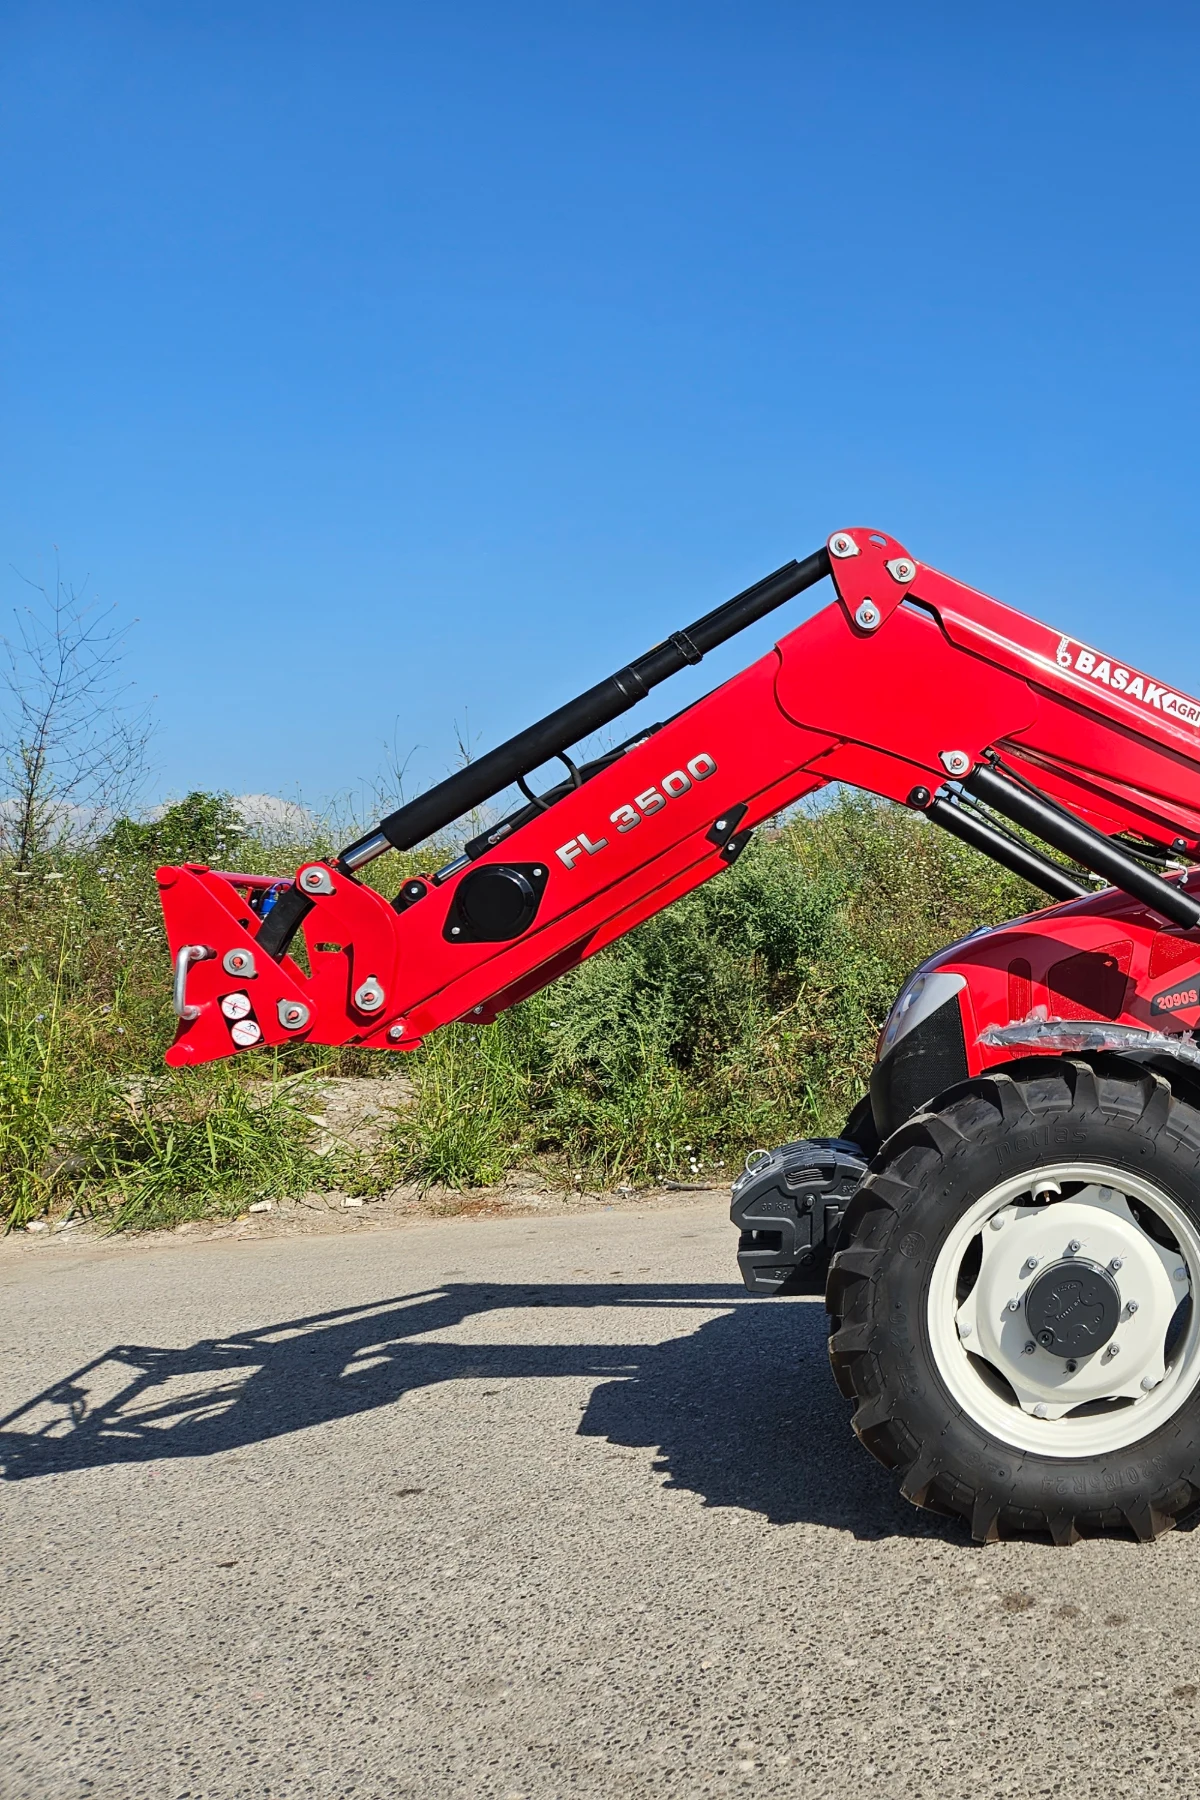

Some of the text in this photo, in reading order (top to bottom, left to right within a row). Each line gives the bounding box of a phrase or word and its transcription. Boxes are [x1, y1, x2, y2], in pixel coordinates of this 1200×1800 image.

[1167, 699, 1200, 722] AGRI
[554, 752, 717, 870] FL 3500
[1156, 989, 1198, 1010] 2090S
[1041, 1454, 1167, 1495] 320/85R24
